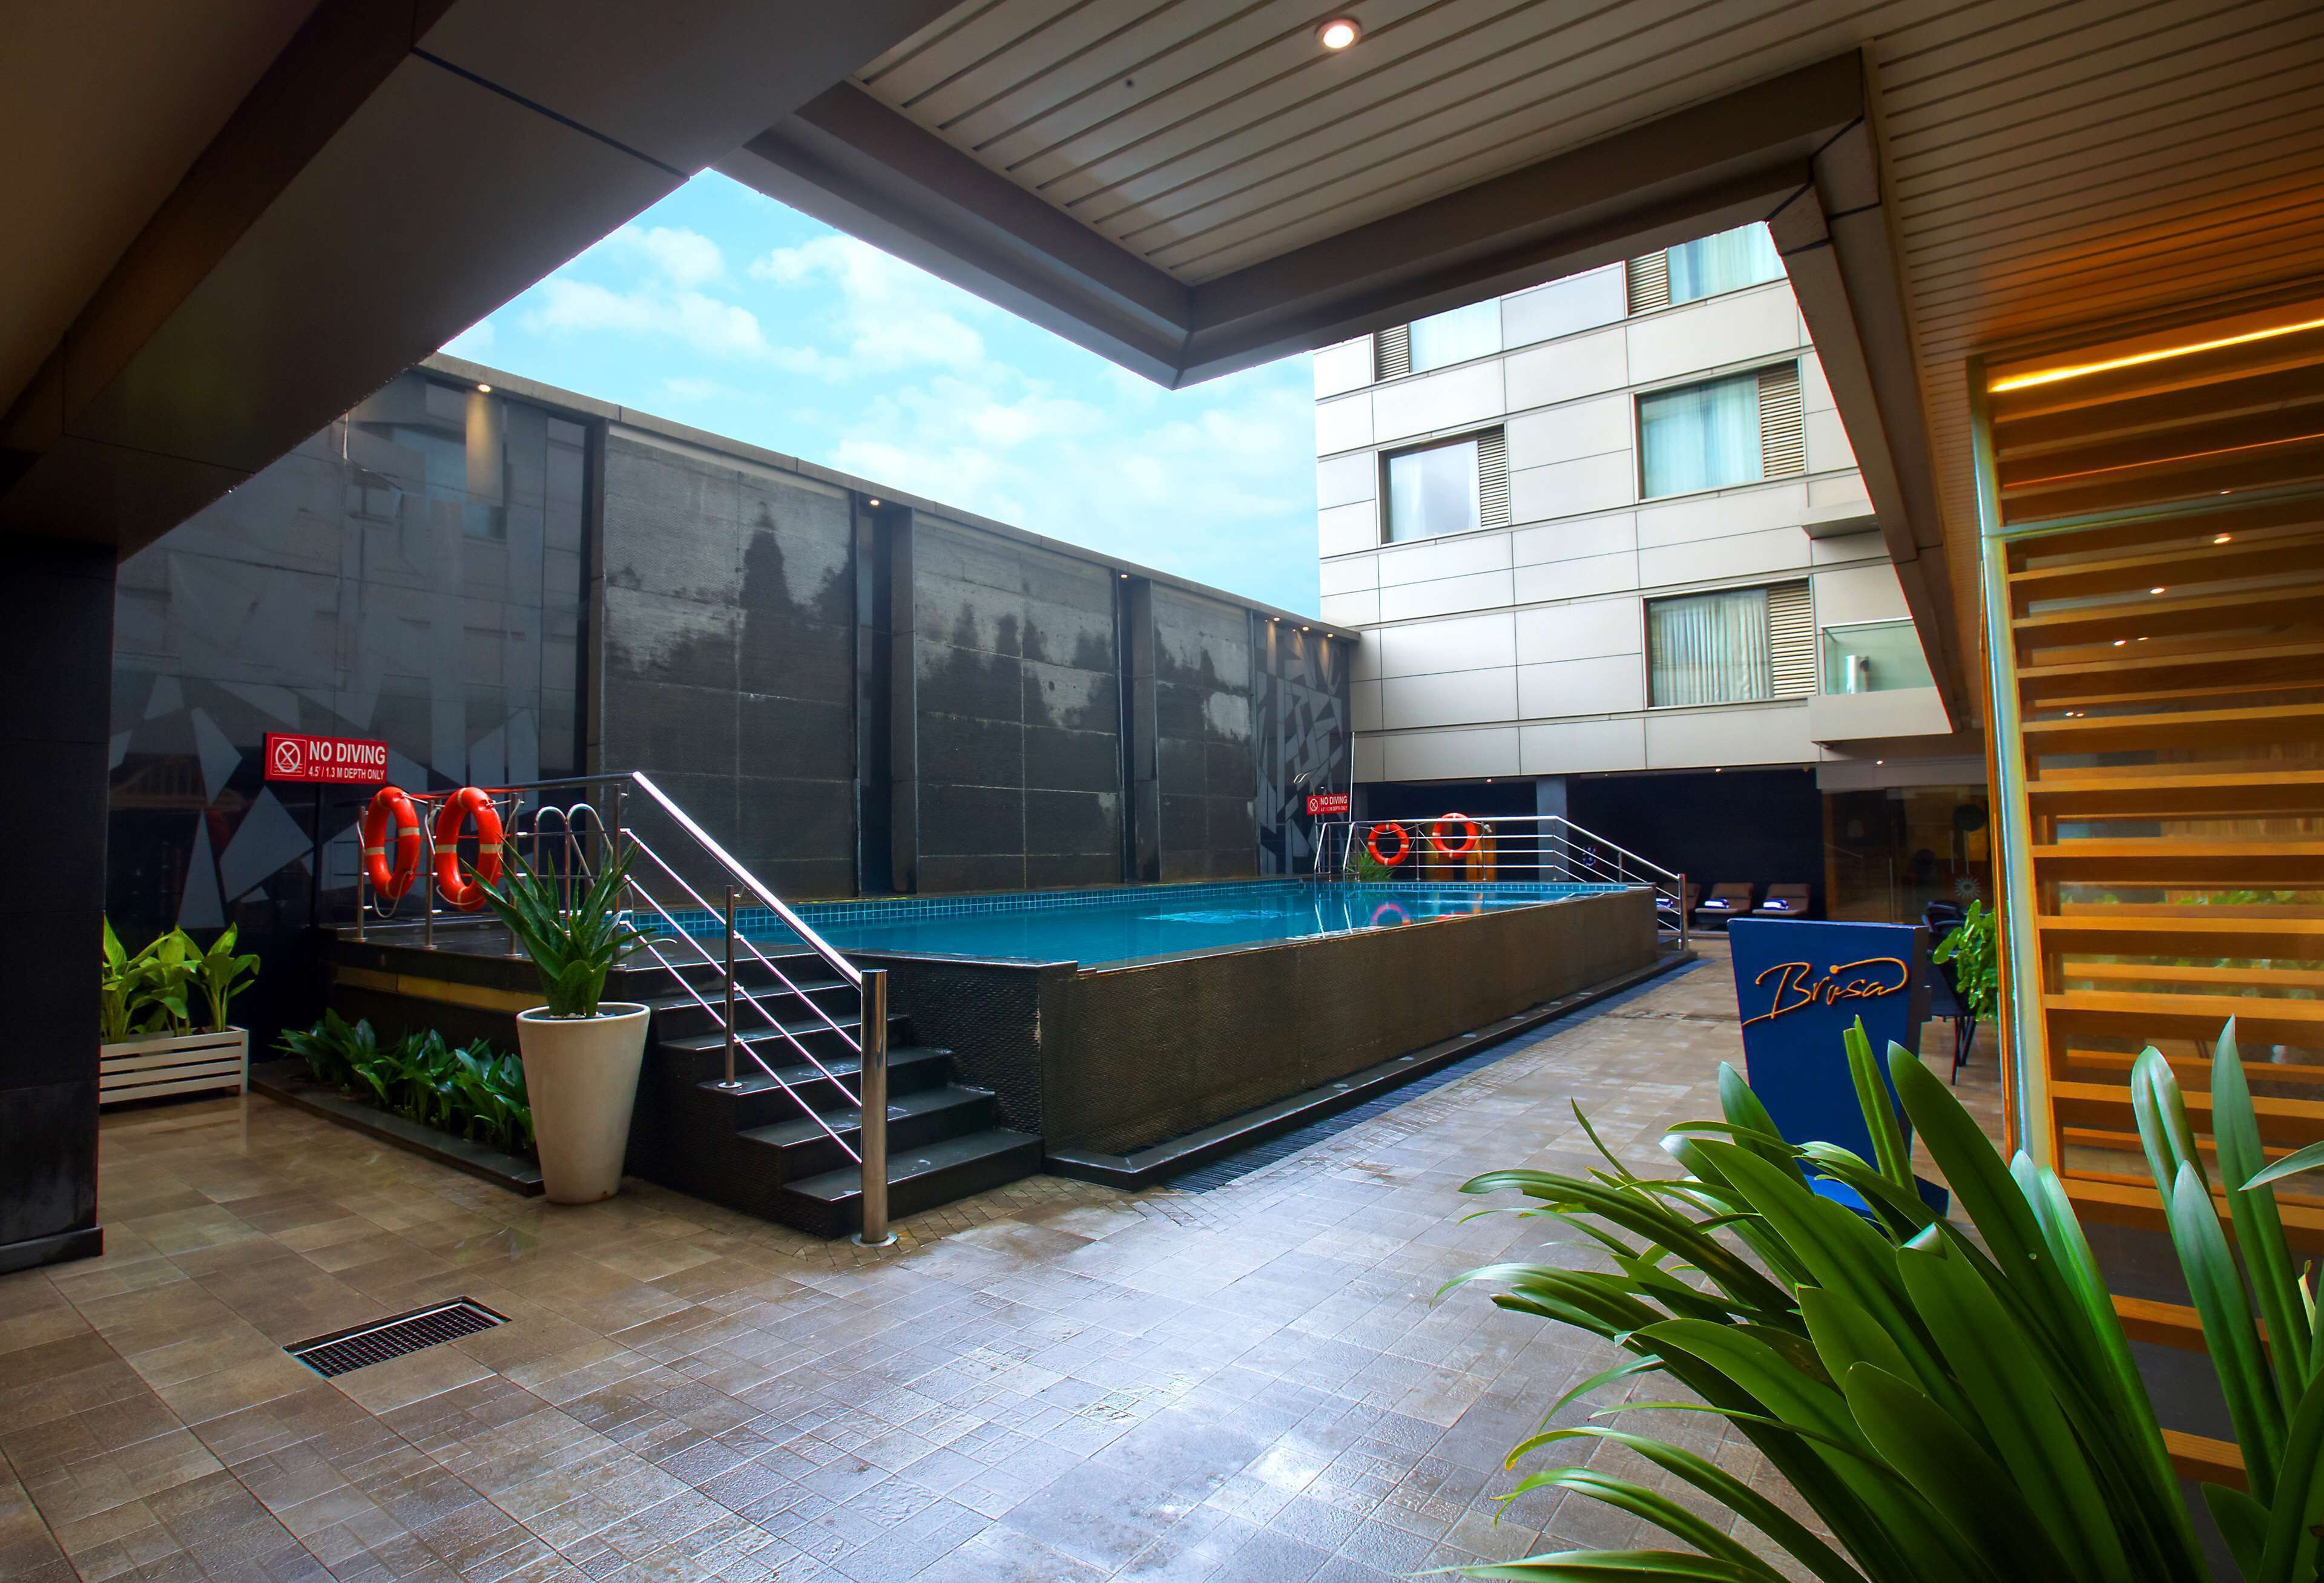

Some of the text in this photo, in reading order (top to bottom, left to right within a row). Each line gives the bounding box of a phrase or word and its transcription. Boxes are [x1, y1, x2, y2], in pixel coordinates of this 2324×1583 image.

[309, 741, 386, 765] NO DIVING
[326, 767, 335, 778] 1.3
[337, 768, 343, 778] M
[344, 768, 366, 780] DEPTH
[367, 769, 384, 780] ONLY
[1320, 795, 1347, 805] NO DIVING
[1741, 957, 1909, 1027] Brisa
